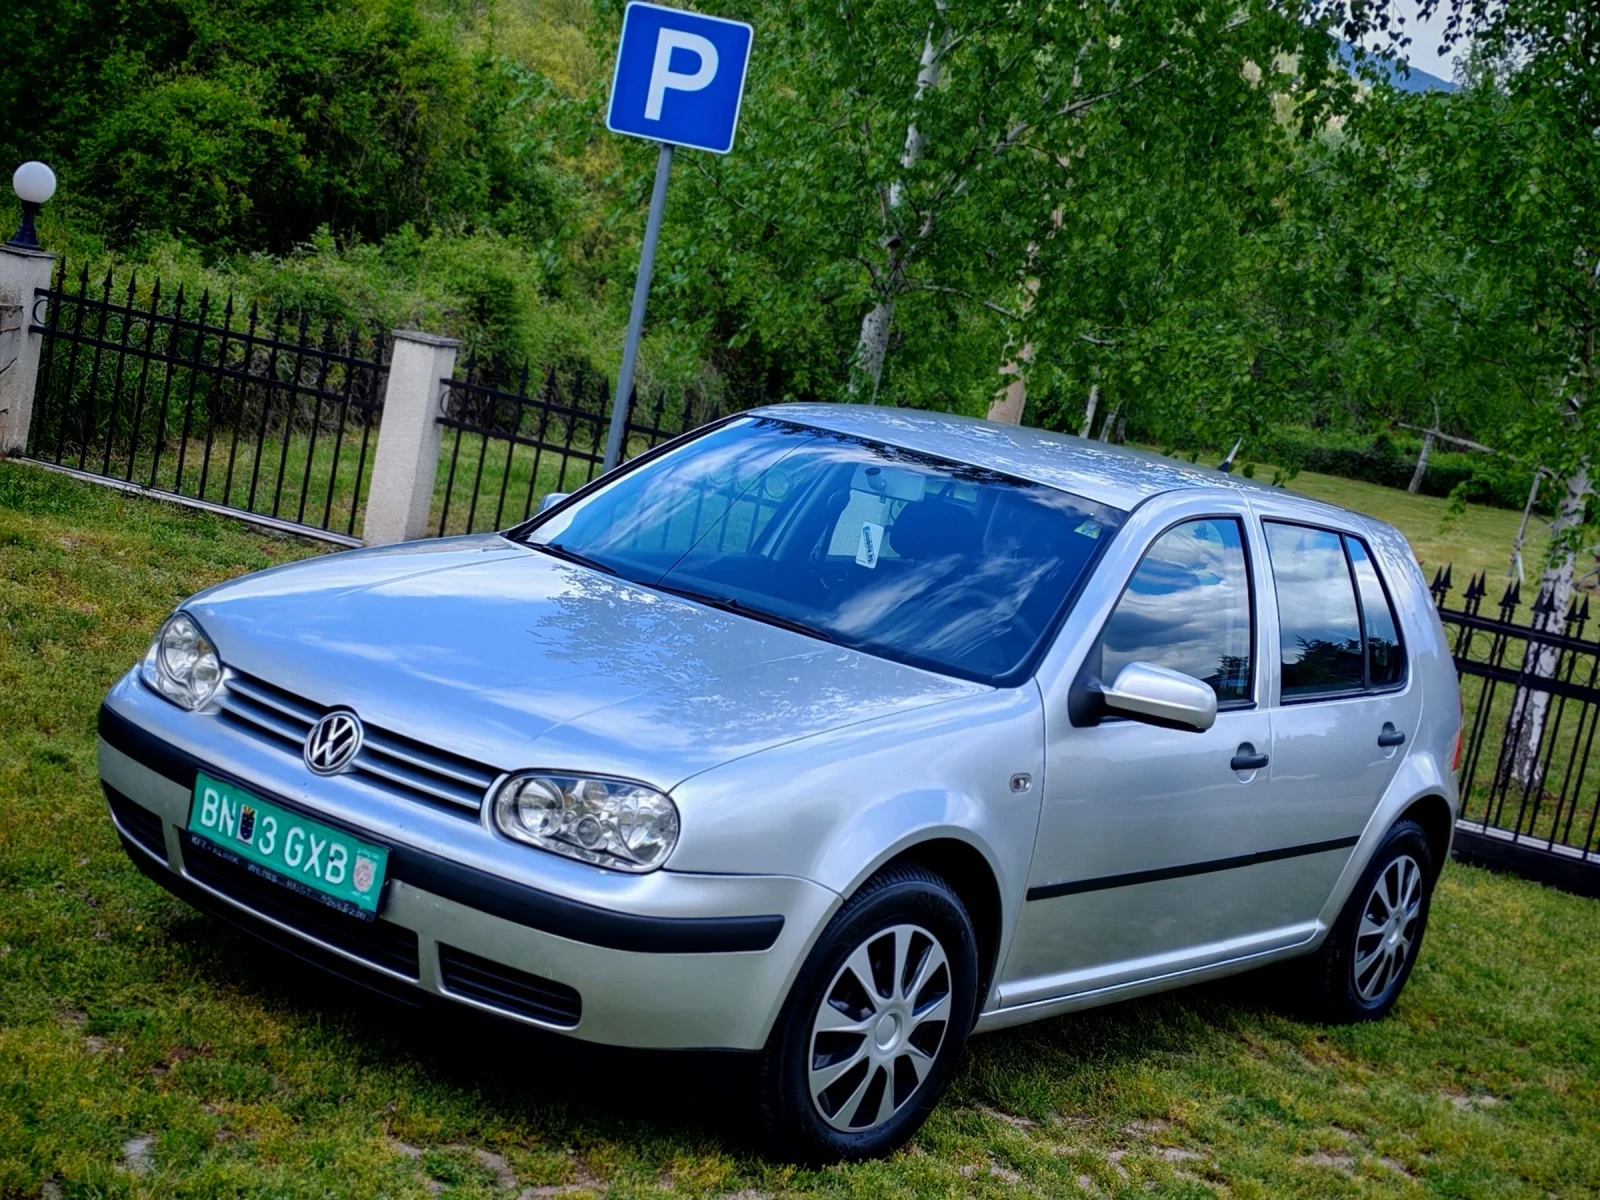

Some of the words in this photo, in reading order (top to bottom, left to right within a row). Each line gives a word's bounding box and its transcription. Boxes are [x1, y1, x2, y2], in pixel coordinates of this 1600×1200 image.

[644, 27, 719, 121] P
[201, 788, 237, 837] BN
[258, 816, 277, 855] 3
[284, 827, 348, 884] GXB
